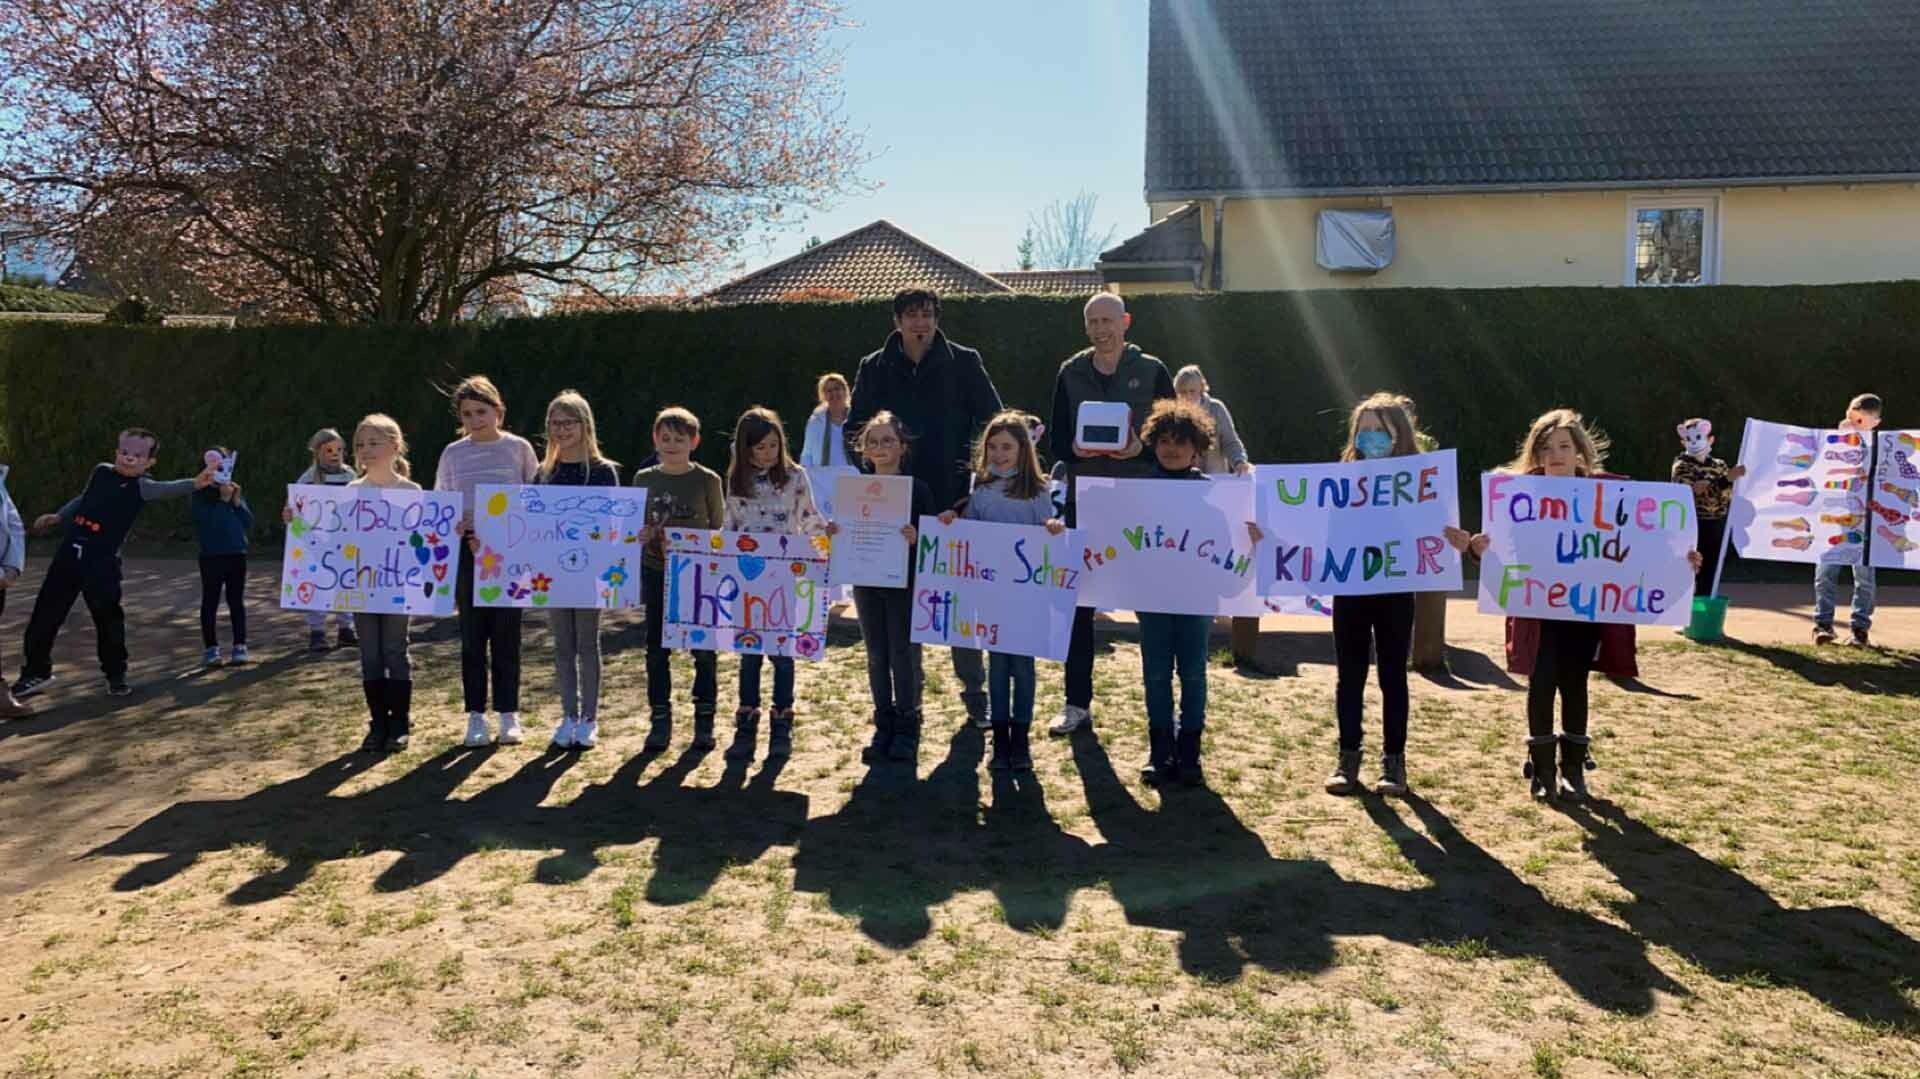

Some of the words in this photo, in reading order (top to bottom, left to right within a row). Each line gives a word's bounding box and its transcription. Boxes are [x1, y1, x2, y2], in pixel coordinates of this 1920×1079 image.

[1276, 465, 1439, 509] UNSERE
[308, 498, 456, 537] 23.152.028
[1123, 525, 1190, 551] Vital
[314, 546, 422, 591] Schritte
[917, 534, 998, 582] Matthias
[1275, 535, 1445, 583] KINDER
[1556, 529, 1630, 564] und
[1499, 563, 1665, 621] Freunde
